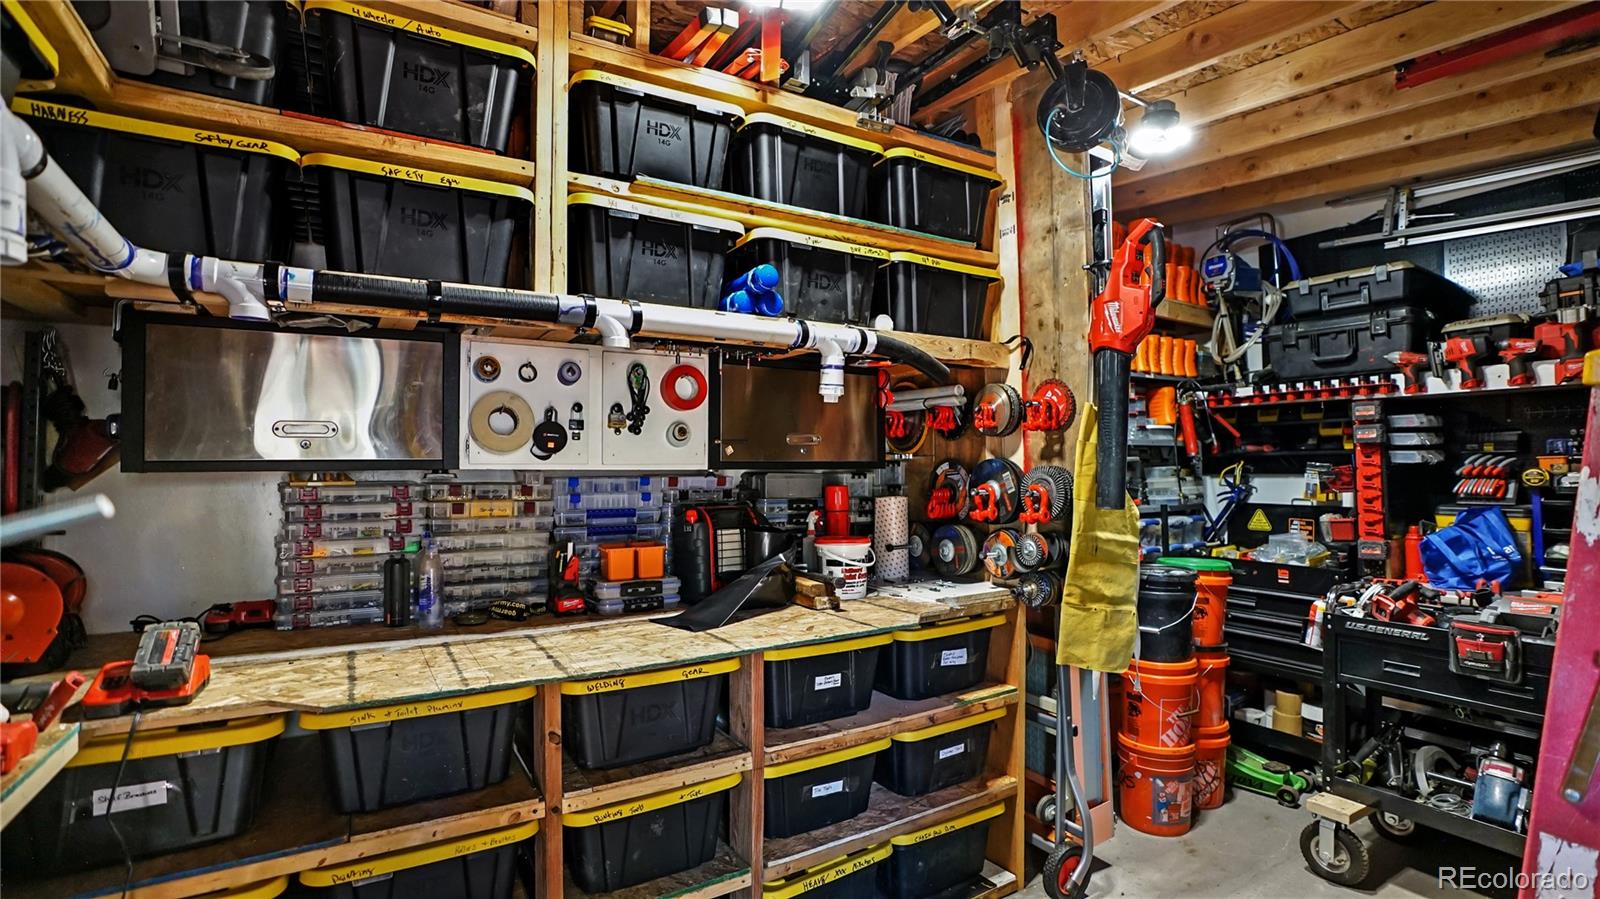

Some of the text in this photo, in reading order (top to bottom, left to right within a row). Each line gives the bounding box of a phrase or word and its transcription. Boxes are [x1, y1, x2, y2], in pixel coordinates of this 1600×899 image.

[416, 23, 442, 37] Auto
[403, 62, 449, 88] HDX
[418, 84, 435, 94] 14G
[31, 103, 89, 125] HARNESS
[646, 119, 682, 141] HDX
[658, 138, 671, 147] 14G
[401, 207, 448, 231] HDX
[641, 241, 678, 260] HDX
[653, 258, 667, 266] 14G
[808, 273, 842, 292] HDX
